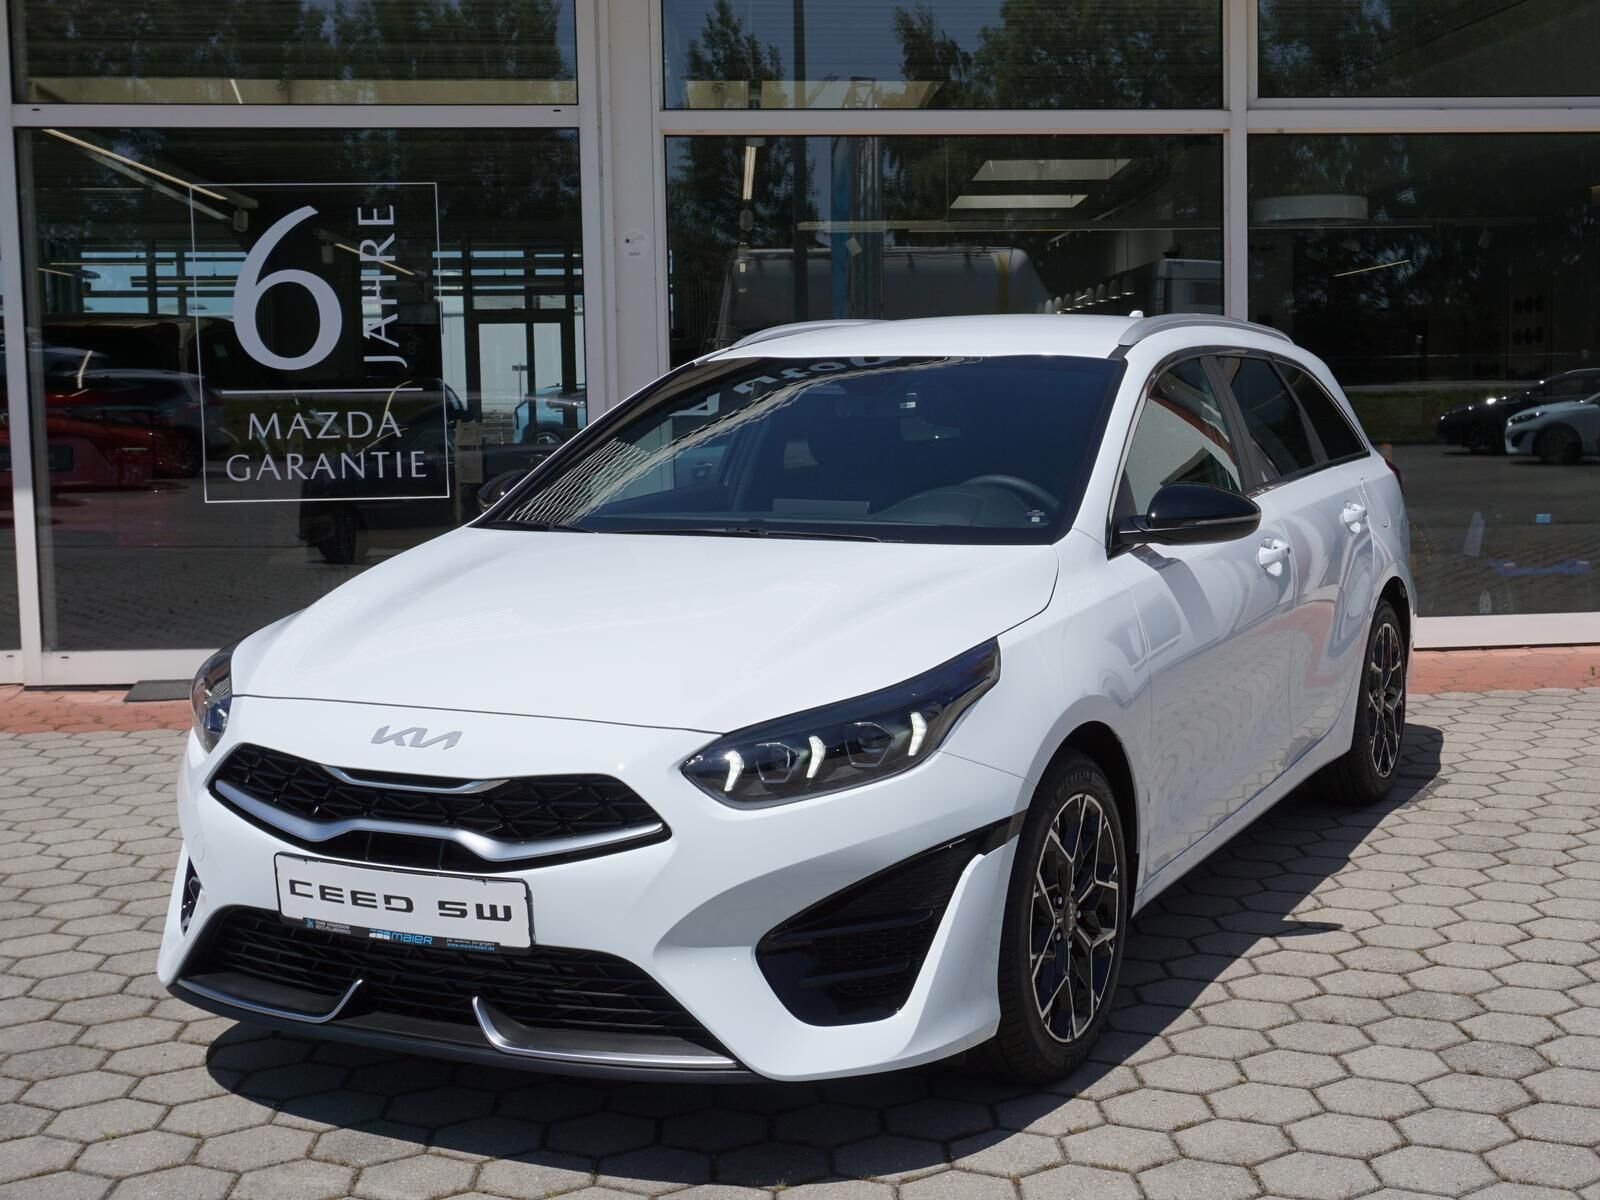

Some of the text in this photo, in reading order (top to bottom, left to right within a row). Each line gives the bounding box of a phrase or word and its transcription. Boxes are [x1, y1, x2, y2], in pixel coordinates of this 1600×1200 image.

[233, 205, 342, 371] 6
[357, 204, 408, 369] JAHRE
[248, 411, 402, 440] MAZDA
[226, 451, 428, 481] GARANTIE
[370, 725, 462, 750] KIA
[288, 879, 512, 922] CEED SW
